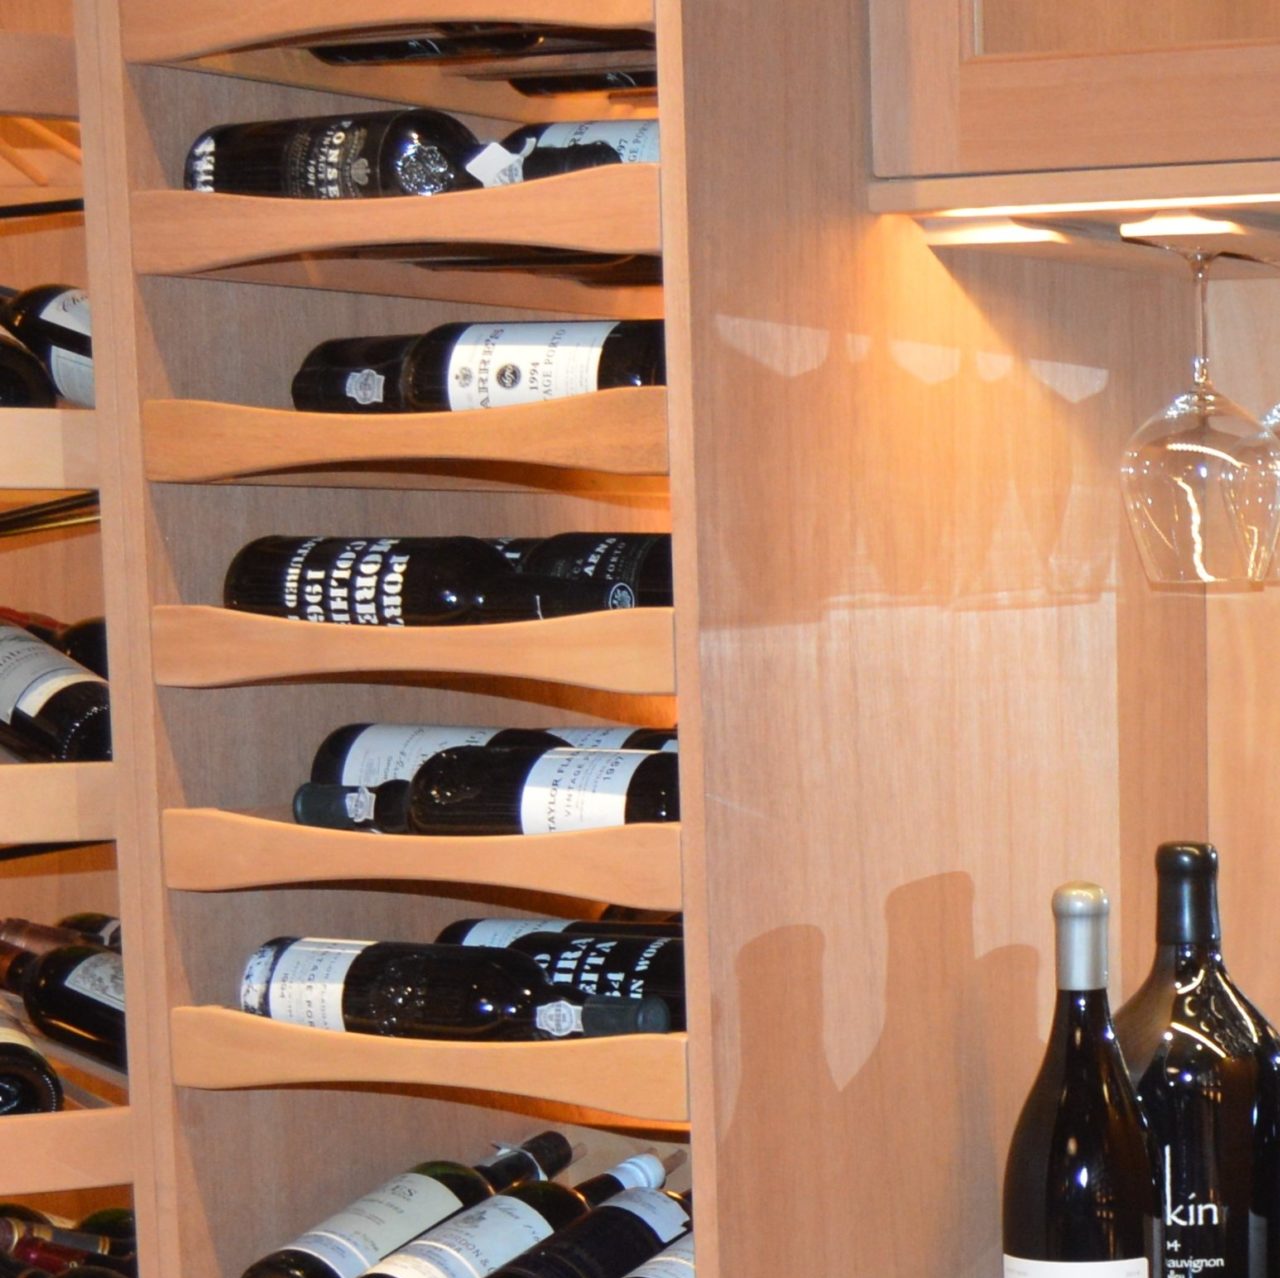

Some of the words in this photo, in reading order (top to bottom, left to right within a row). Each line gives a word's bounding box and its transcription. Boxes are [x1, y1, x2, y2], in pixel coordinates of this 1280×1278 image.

[478, 328, 504, 410] ARRE'S
[355, 538, 401, 625] MORE
[383, 553, 411, 629] PORT
[1166, 1256, 1225, 1274] auvignon
